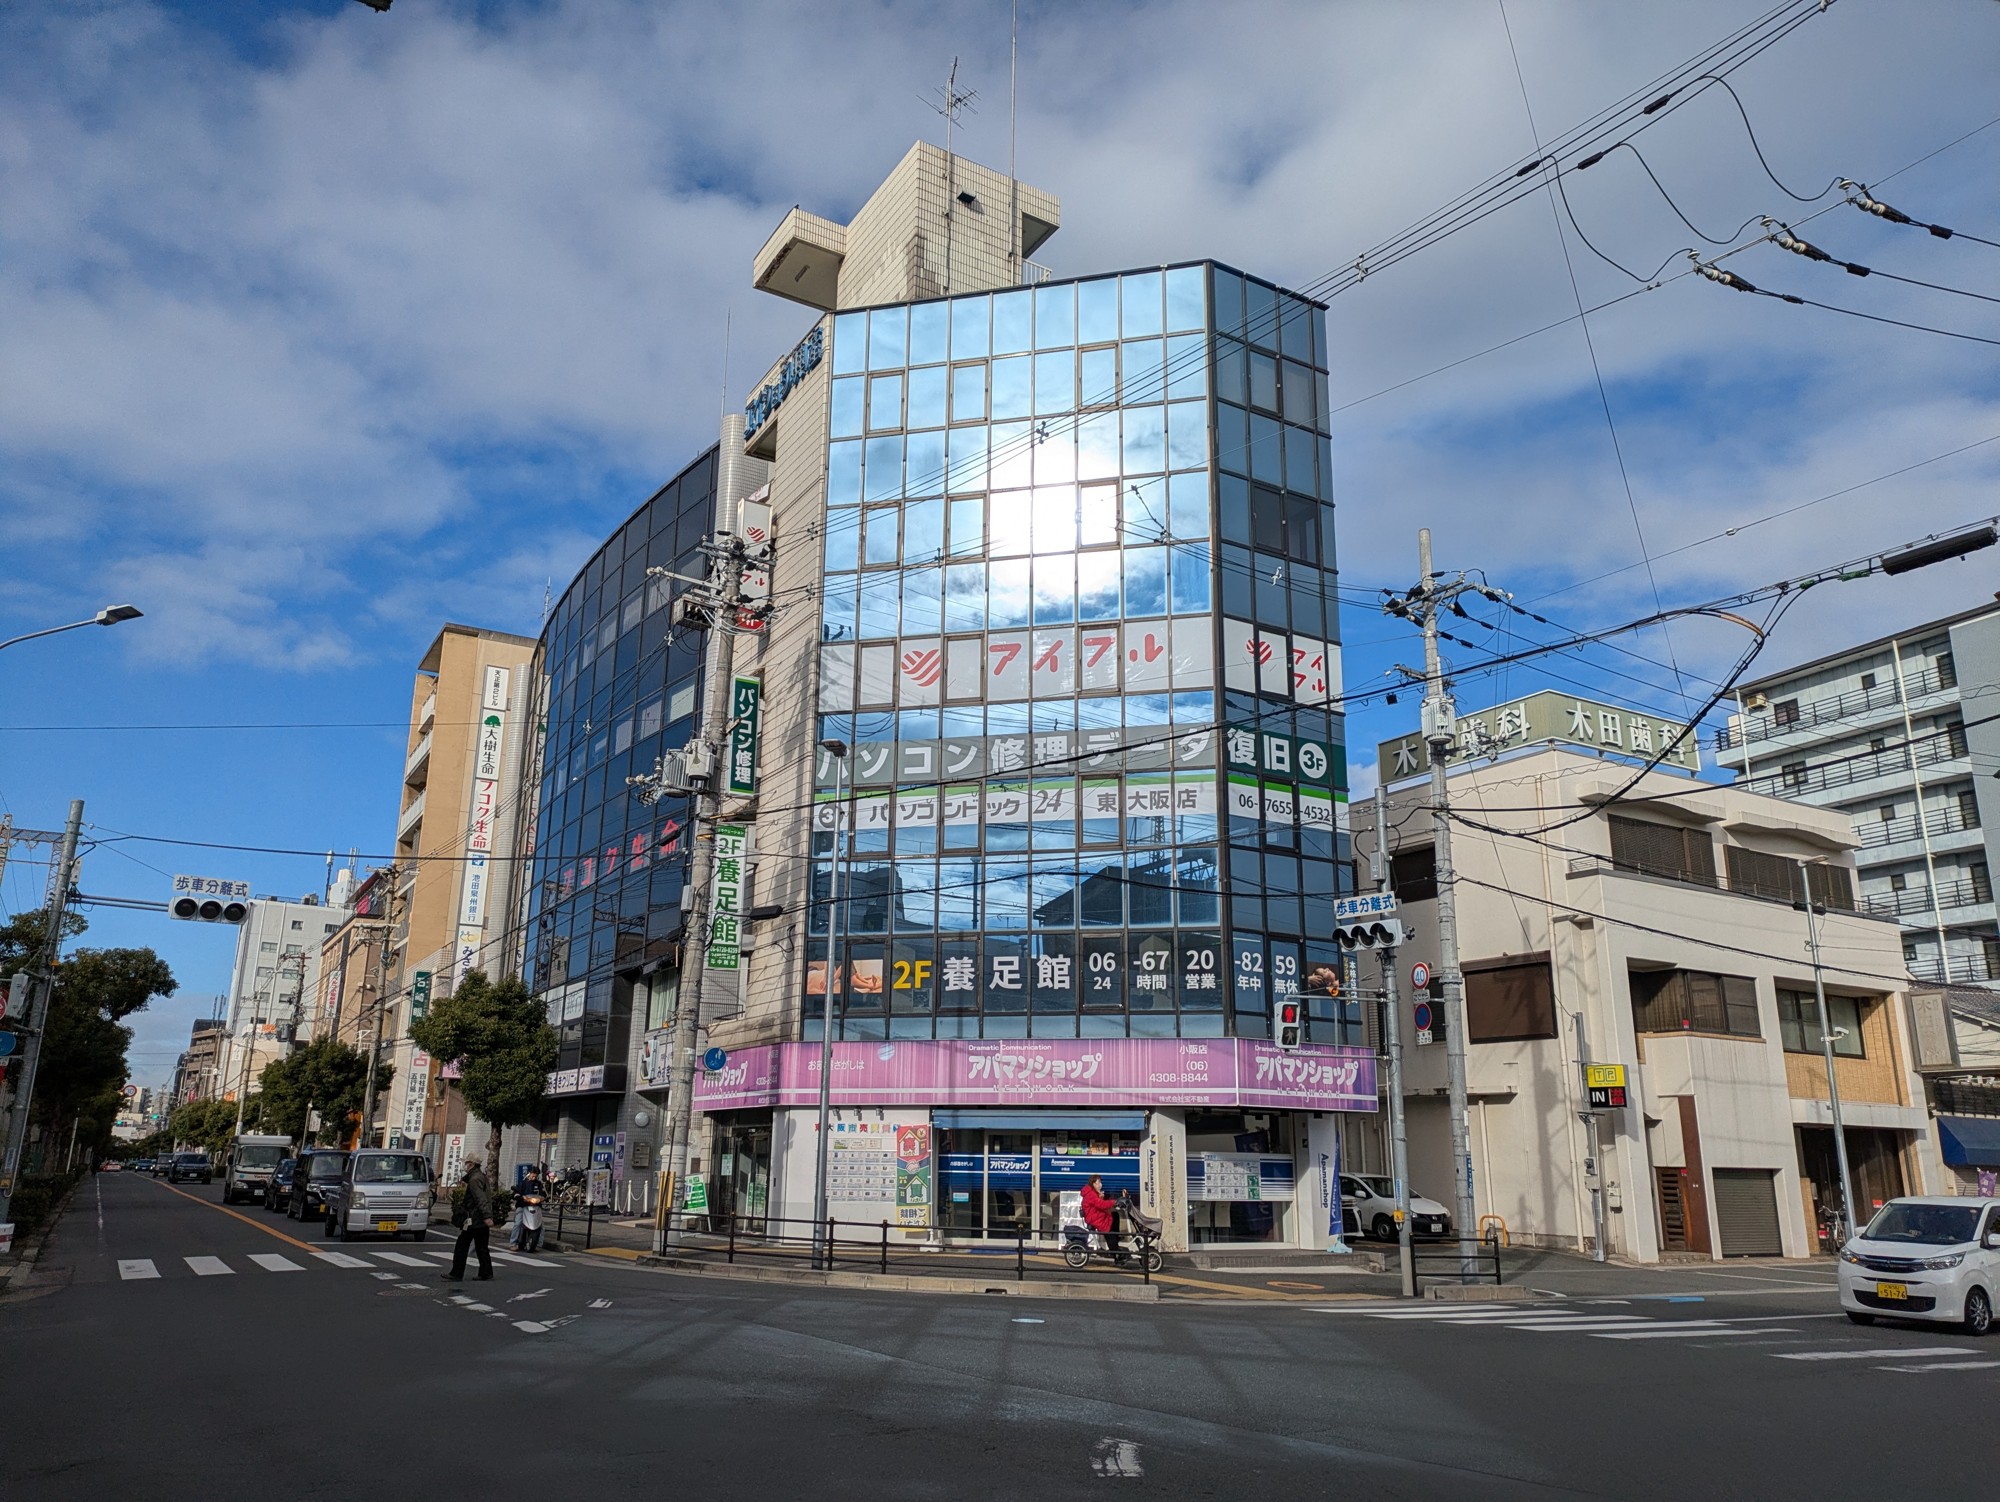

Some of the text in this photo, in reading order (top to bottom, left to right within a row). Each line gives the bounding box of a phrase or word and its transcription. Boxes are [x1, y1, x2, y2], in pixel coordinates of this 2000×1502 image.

[989, 633, 1164, 675] アイフル
[735, 688, 755, 784] パソコン修理
[1393, 703, 1530, 776] 木歯科
[1566, 702, 1686, 762] 木田歯科
[482, 729, 497, 775] 大樹生命
[1227, 727, 1324, 773] 復旧 3F
[473, 780, 493, 848] フコク生命
[1097, 789, 1197, 812] 東大阪店
[718, 838, 741, 854] 2F
[176, 876, 248, 897] 歩車分離式
[468, 874, 480, 921] 池田泉州銀行
[714, 859, 740, 943] 養足館
[1336, 894, 1394, 916] 歩車分離式
[893, 953, 1071, 991] 2F 養足館
[1416, 970, 1425, 983] 40
[1179, 1045, 1208, 1055] 小阪店
[968, 1052, 1103, 1080] アパマンショップ
[1149, 1072, 1208, 1083] 4308-8844
[1186, 1060, 1208, 1071] (06)
[1256, 1056, 1358, 1085] アパマンショップ
[1592, 1091, 1605, 1102] IN
[990, 1161, 1030, 1170] アパマンショップ
